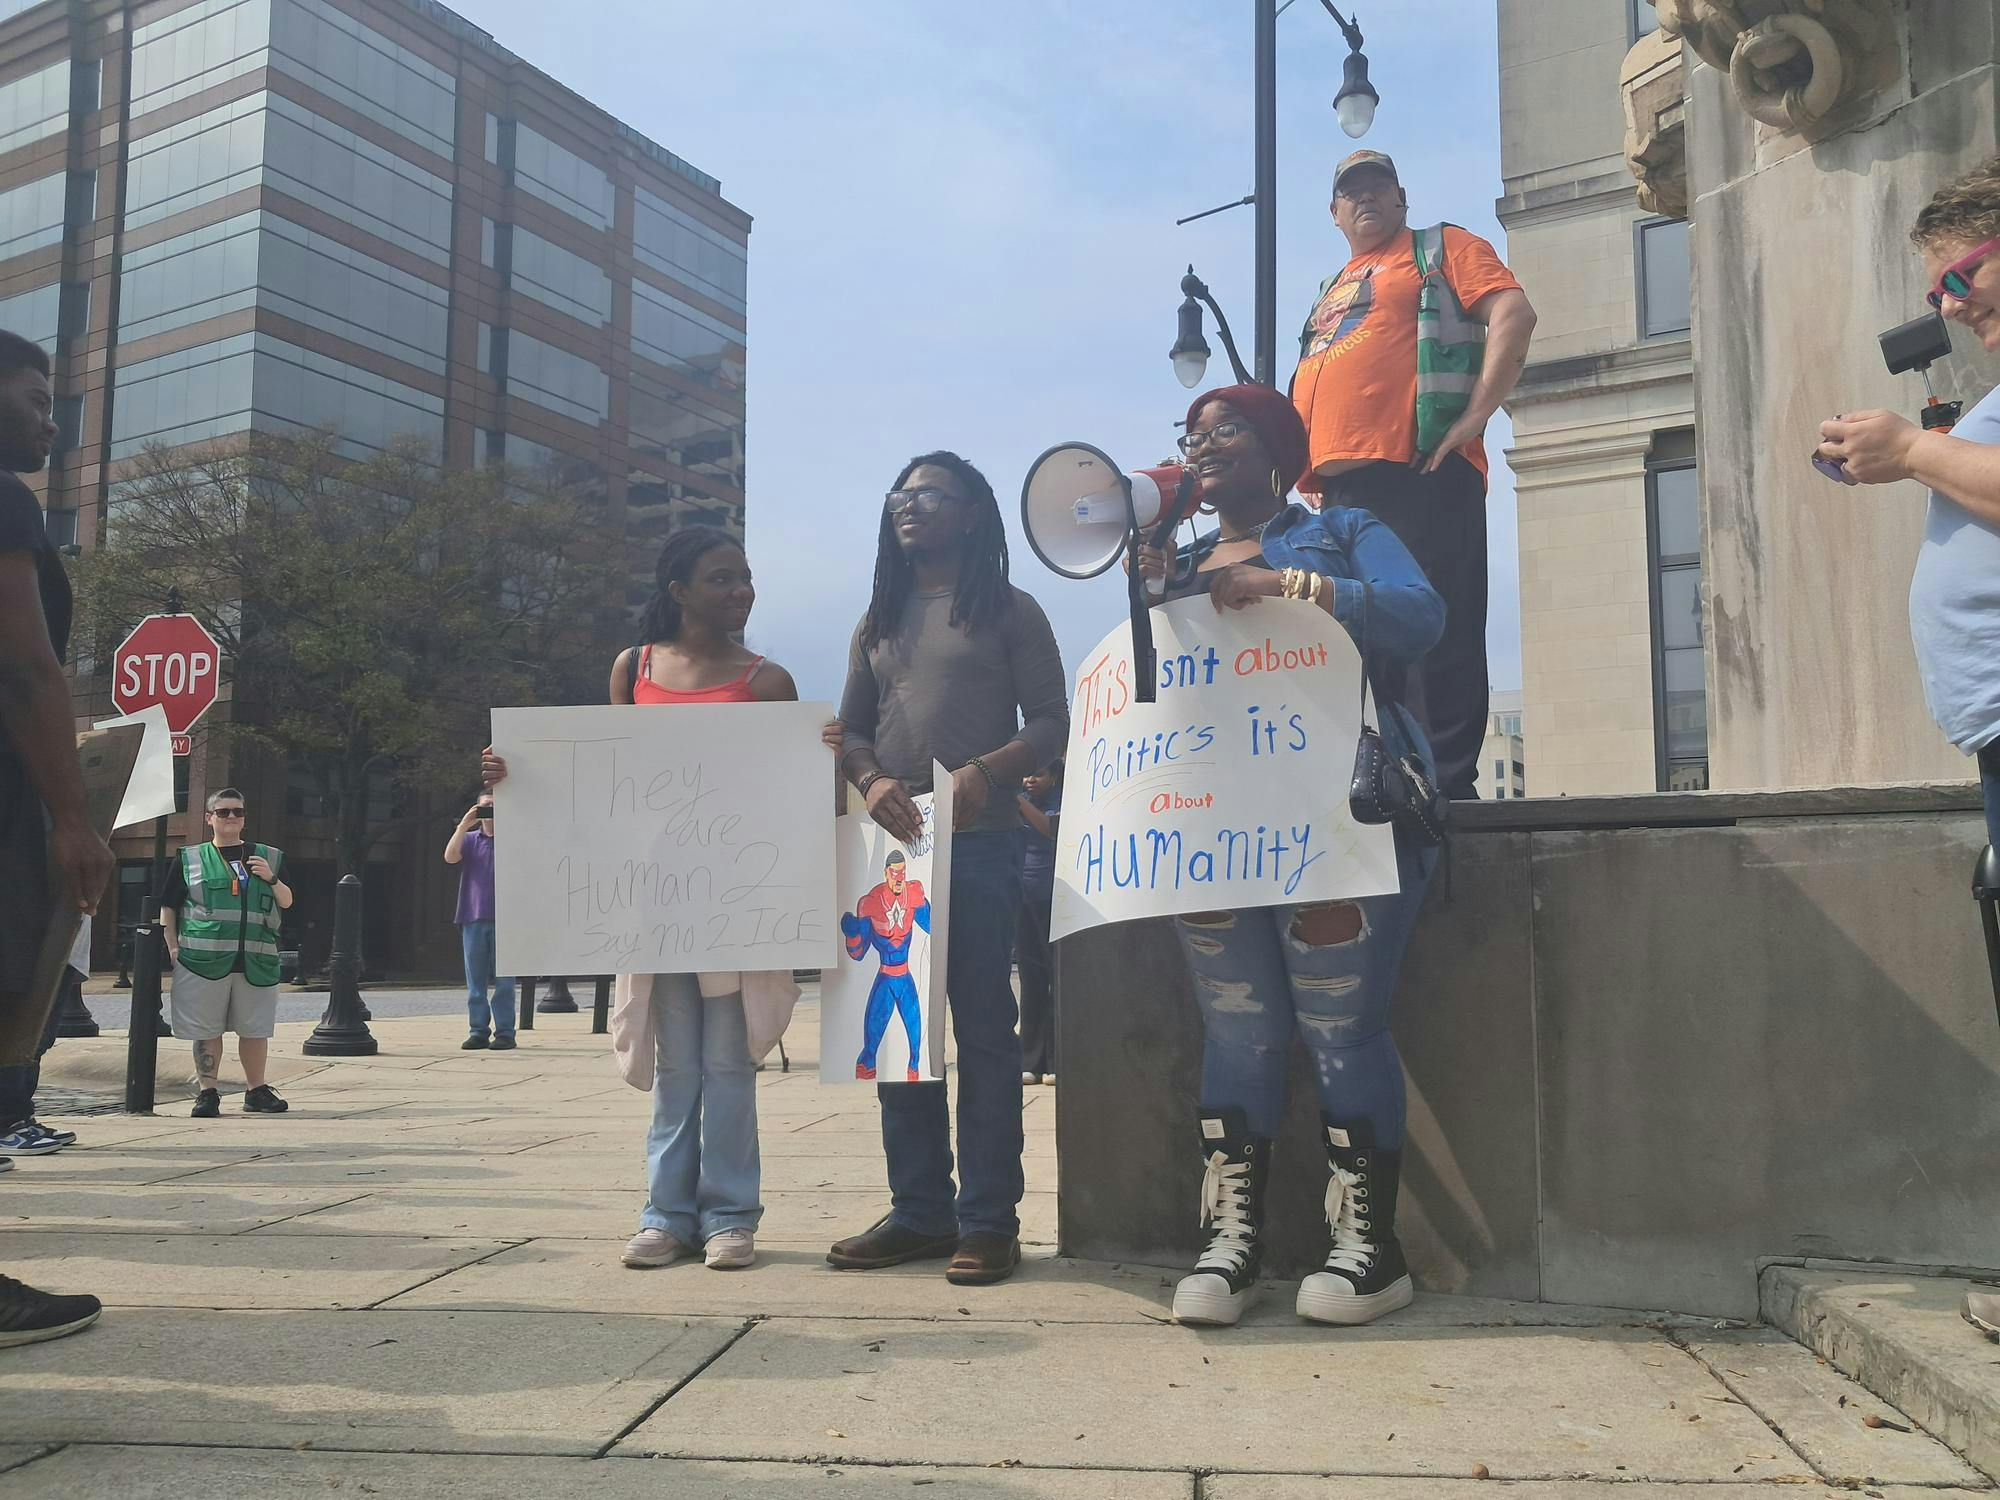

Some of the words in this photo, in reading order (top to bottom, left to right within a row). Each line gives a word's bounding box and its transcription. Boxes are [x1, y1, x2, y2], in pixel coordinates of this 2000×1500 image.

[1324, 327, 1372, 364] CIRCUS
[120, 652, 212, 698] STOP
[1234, 638, 1328, 676] about
[171, 739, 185, 751] AY
[526, 736, 720, 836] They
[1150, 792, 1214, 814] about
[677, 813, 742, 848] are
[720, 841, 802, 905] 2
[580, 922, 644, 968] Say
[706, 913, 736, 952] 2
[743, 907, 829, 948] ICE
